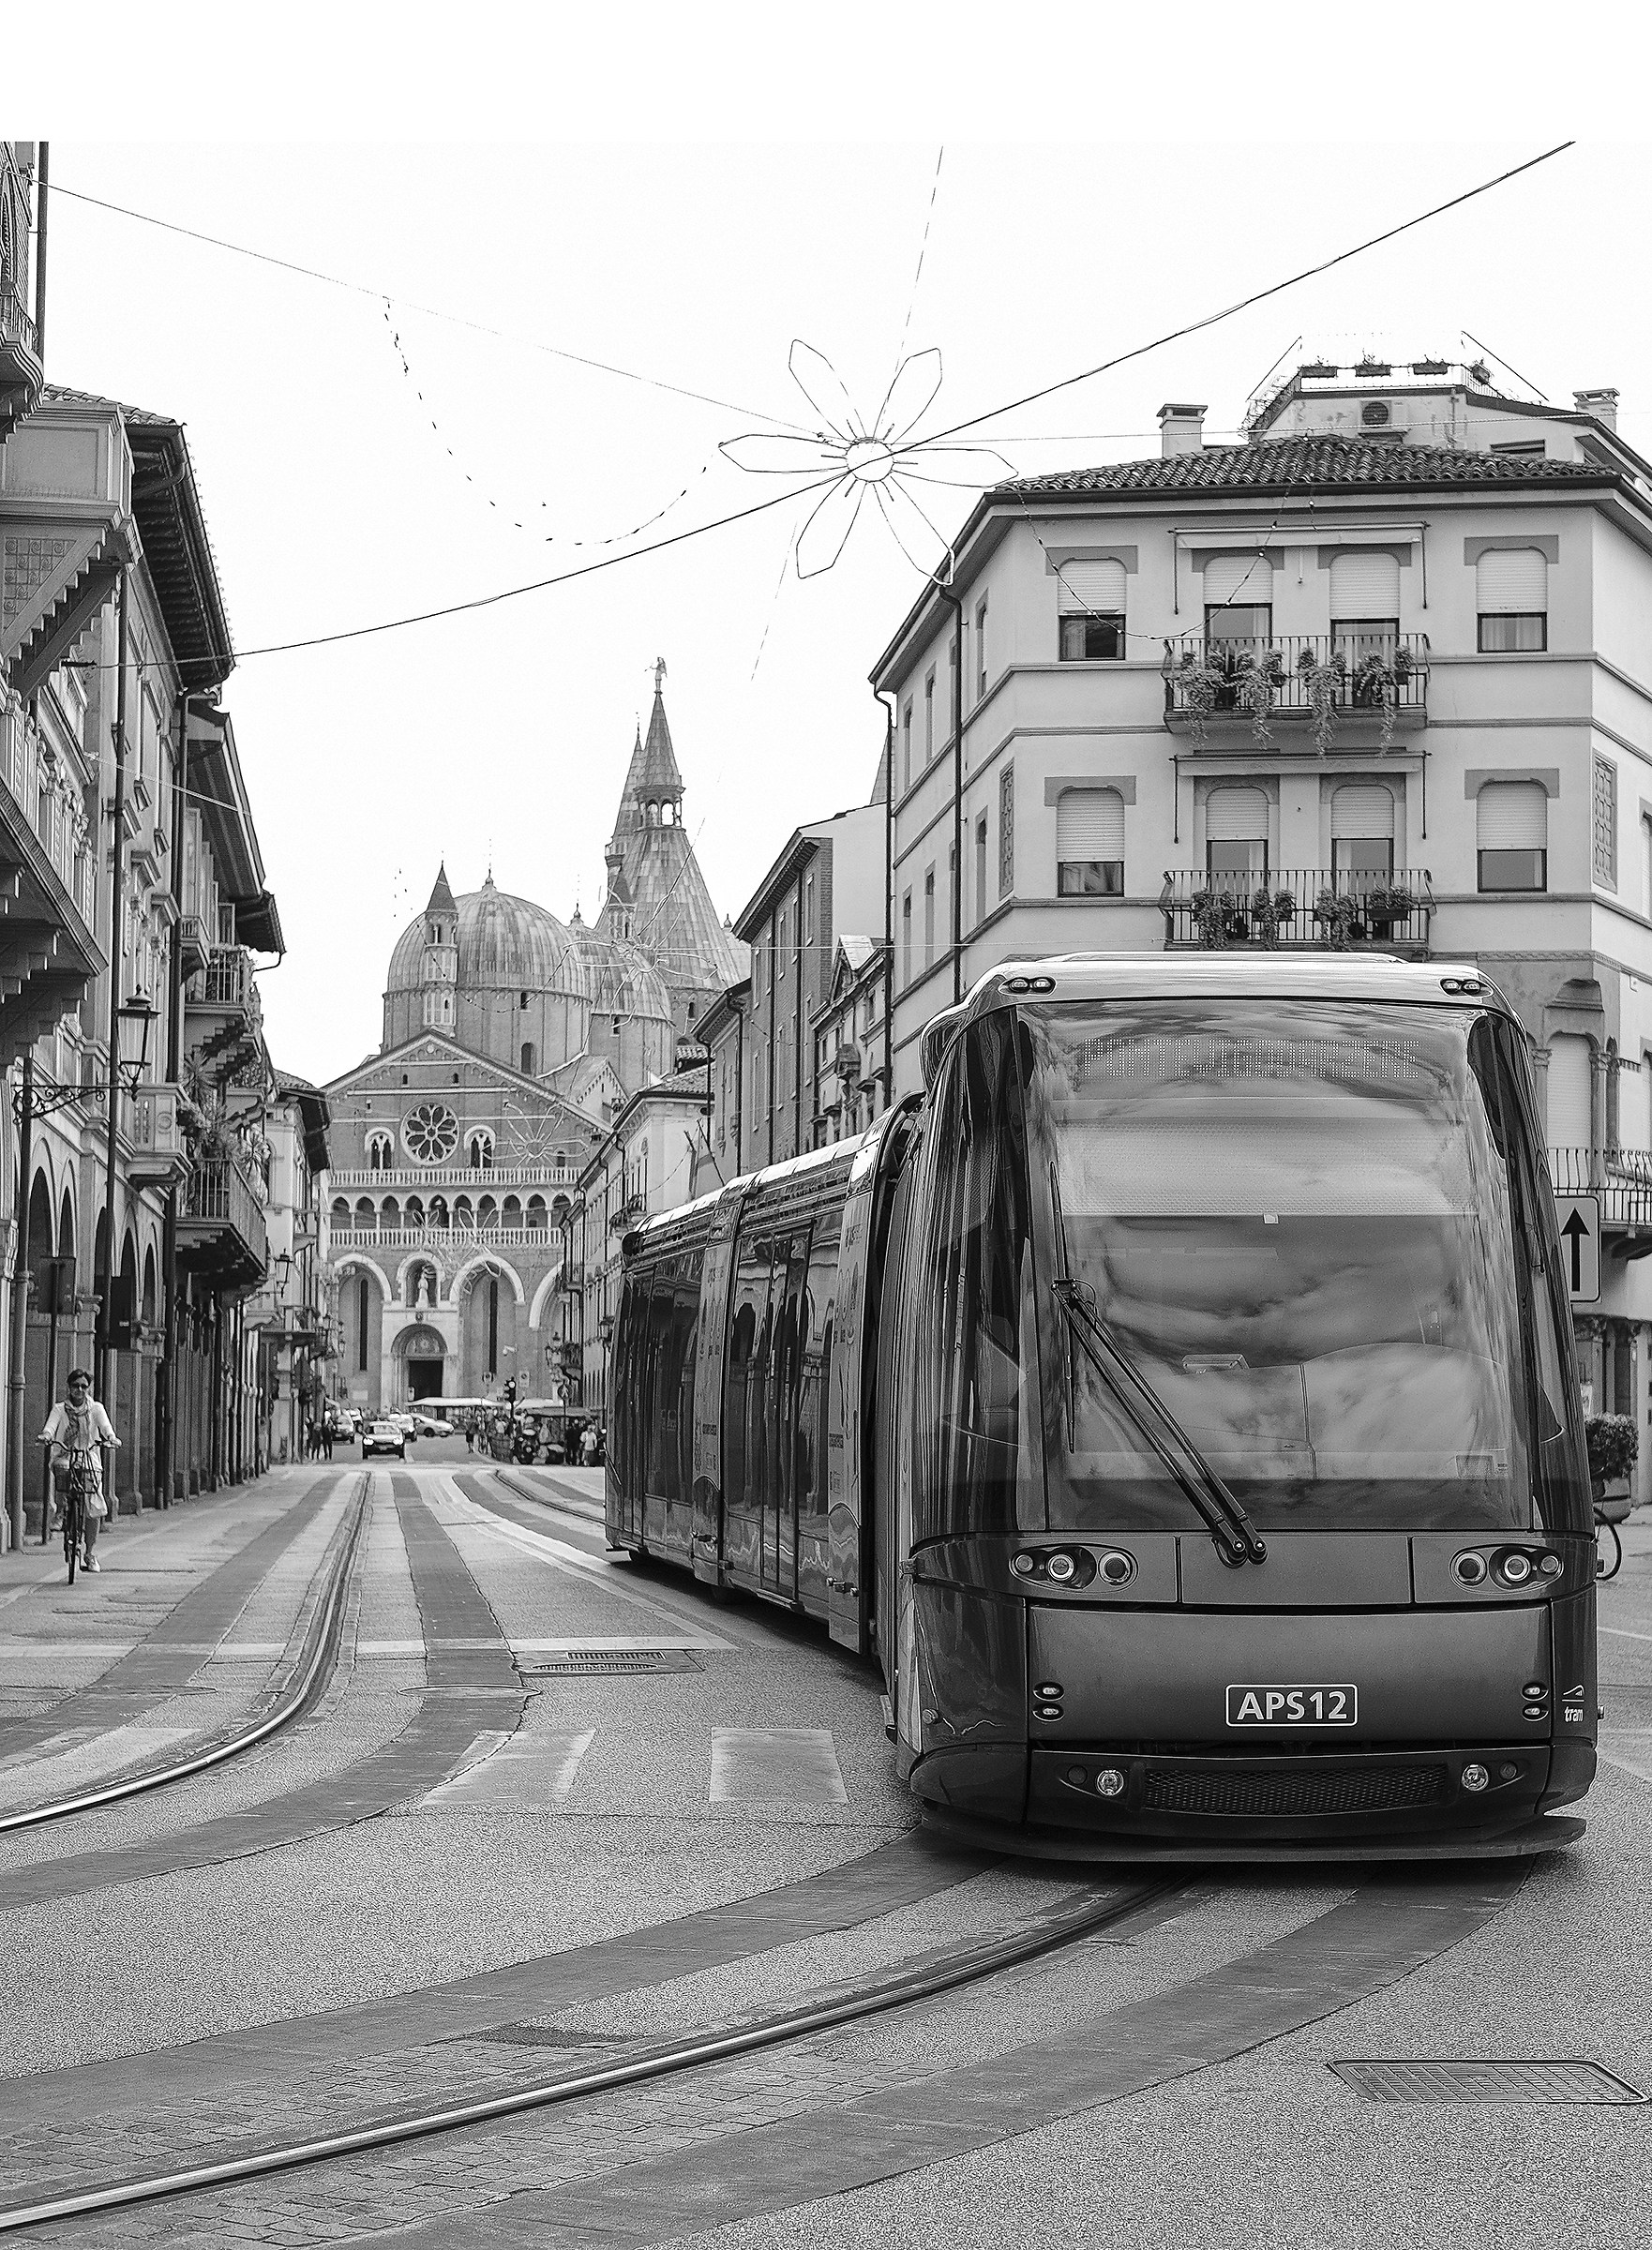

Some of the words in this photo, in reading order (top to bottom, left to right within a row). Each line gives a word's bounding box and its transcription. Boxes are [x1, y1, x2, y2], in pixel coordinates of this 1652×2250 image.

[1084, 1038, 1419, 1077] PONTEVIGODARZERE
[1237, 1690, 1347, 1720] APS12
[1564, 1706, 1584, 1722] tram
